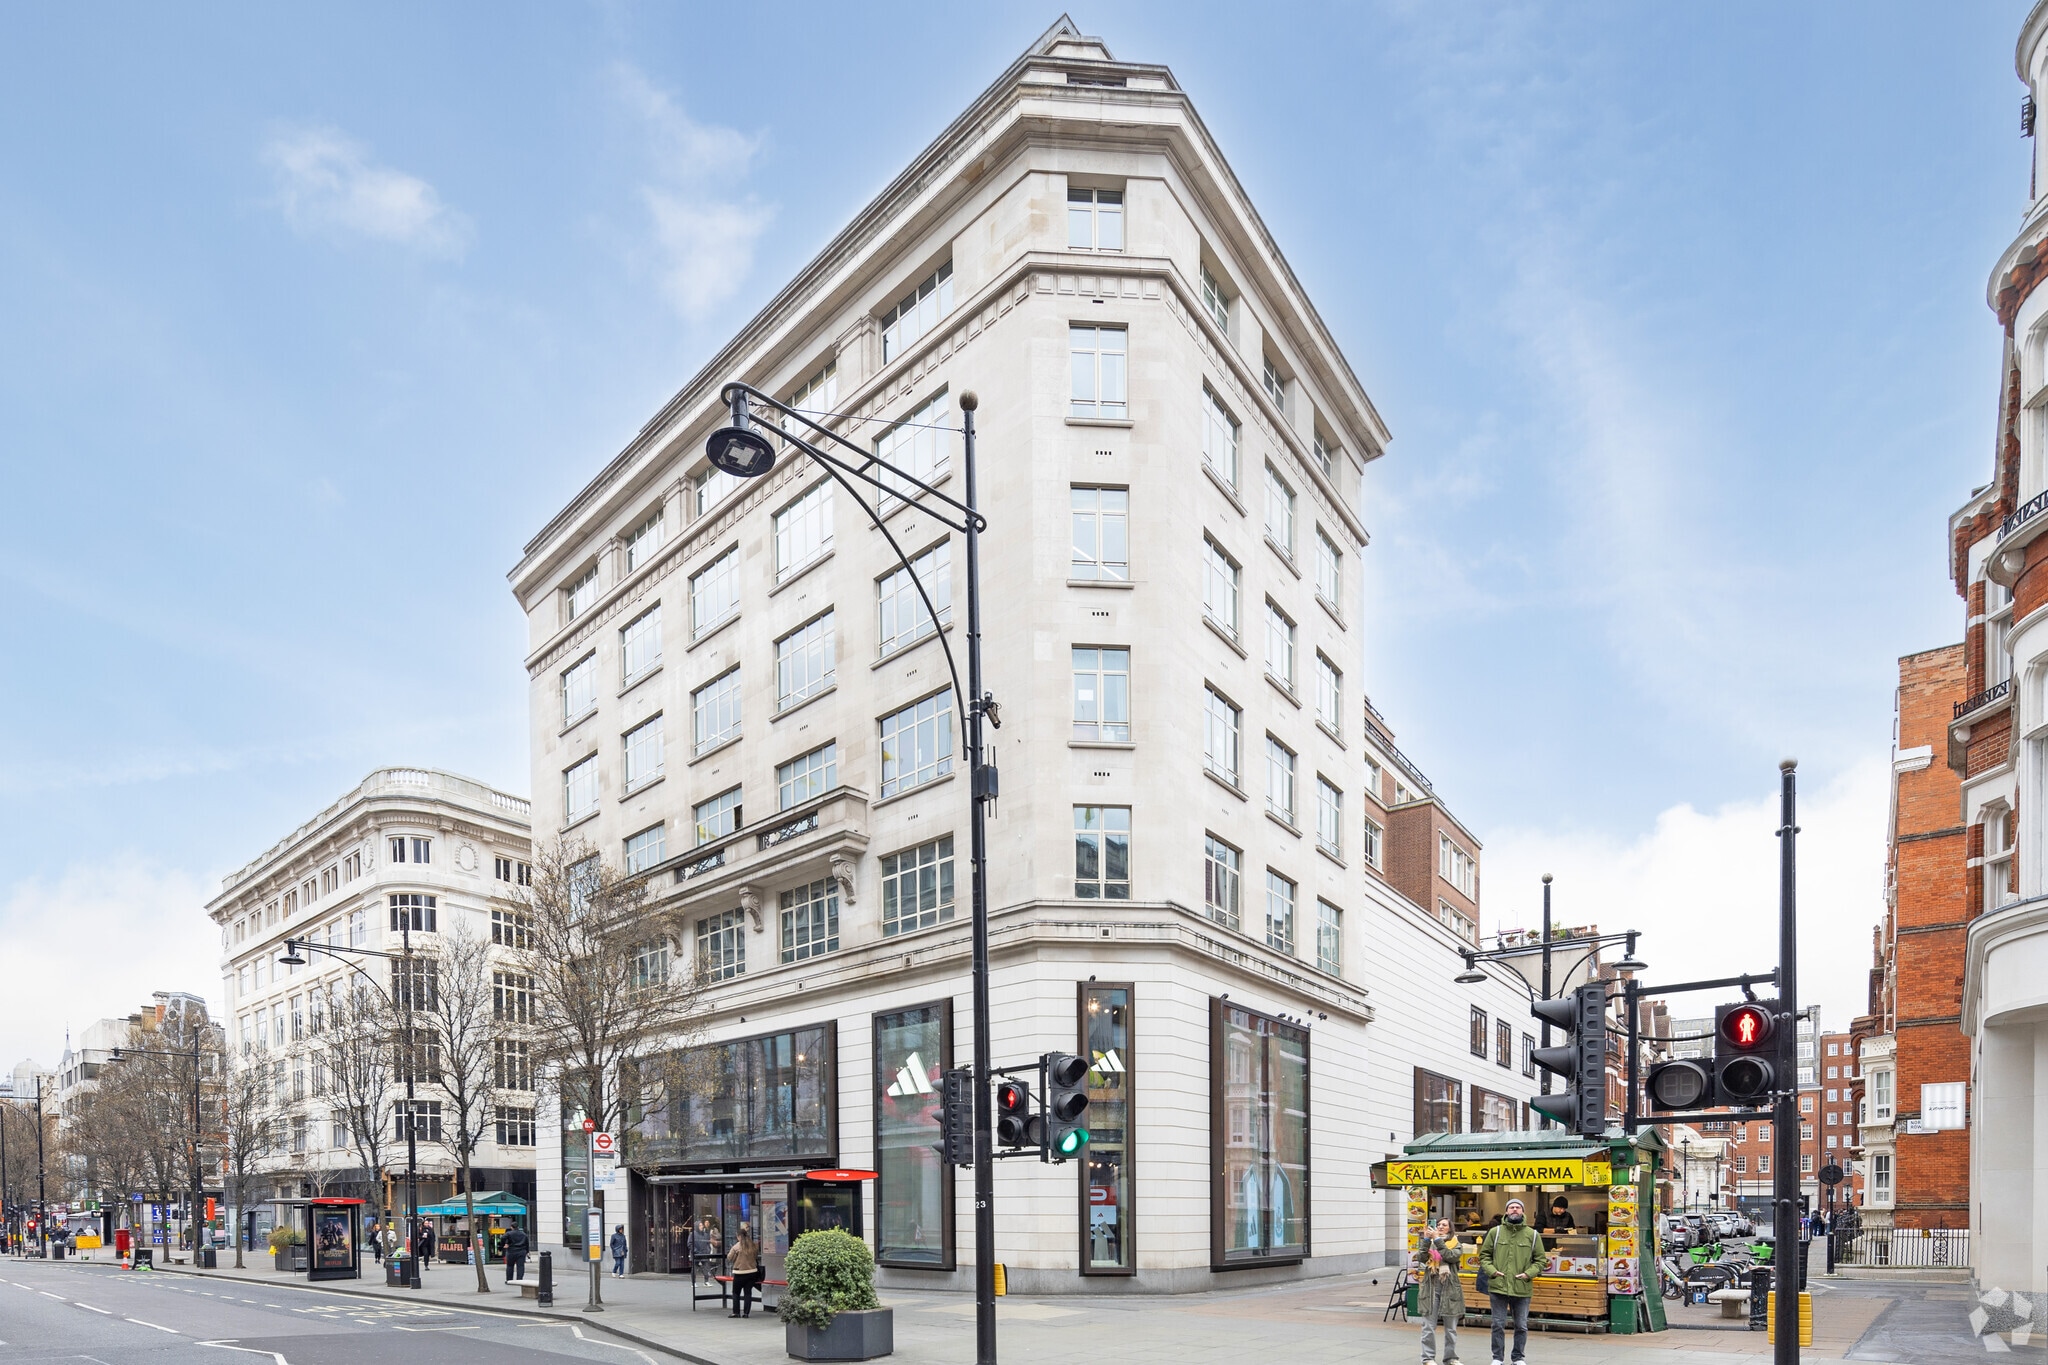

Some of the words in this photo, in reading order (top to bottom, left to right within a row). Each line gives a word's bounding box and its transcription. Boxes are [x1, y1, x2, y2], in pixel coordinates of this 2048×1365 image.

[1405, 1168, 1467, 1180] FALAFEL
[1471, 1172, 1478, 1180] &
[1480, 1167, 1574, 1180] SHAWARMA
[440, 1243, 463, 1251] FALAFEL
